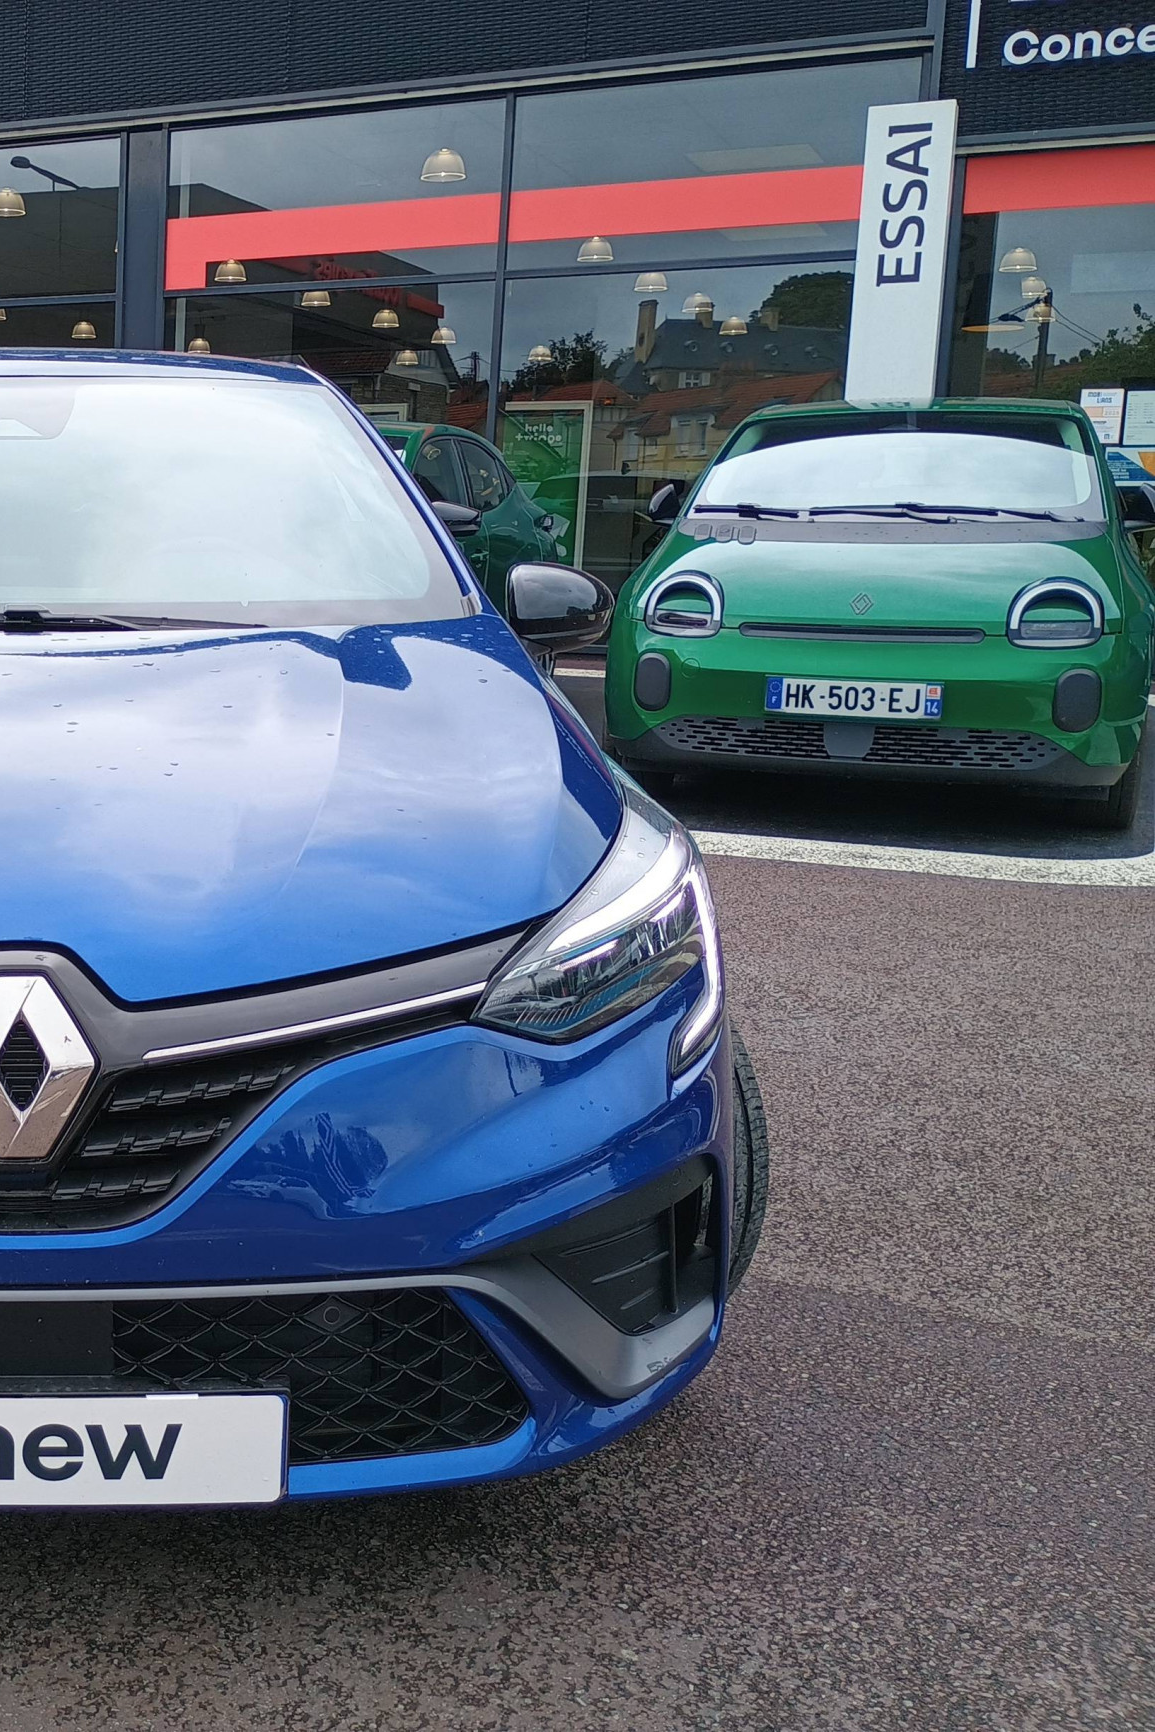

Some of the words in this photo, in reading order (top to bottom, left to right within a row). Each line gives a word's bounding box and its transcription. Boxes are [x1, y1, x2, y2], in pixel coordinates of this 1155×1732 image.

[876, 122, 934, 287] ESSAI
[525, 423, 554, 432] hello
[771, 696, 778, 704] F
[785, 683, 921, 714] HK-503-EJ
[925, 701, 939, 715] 14
